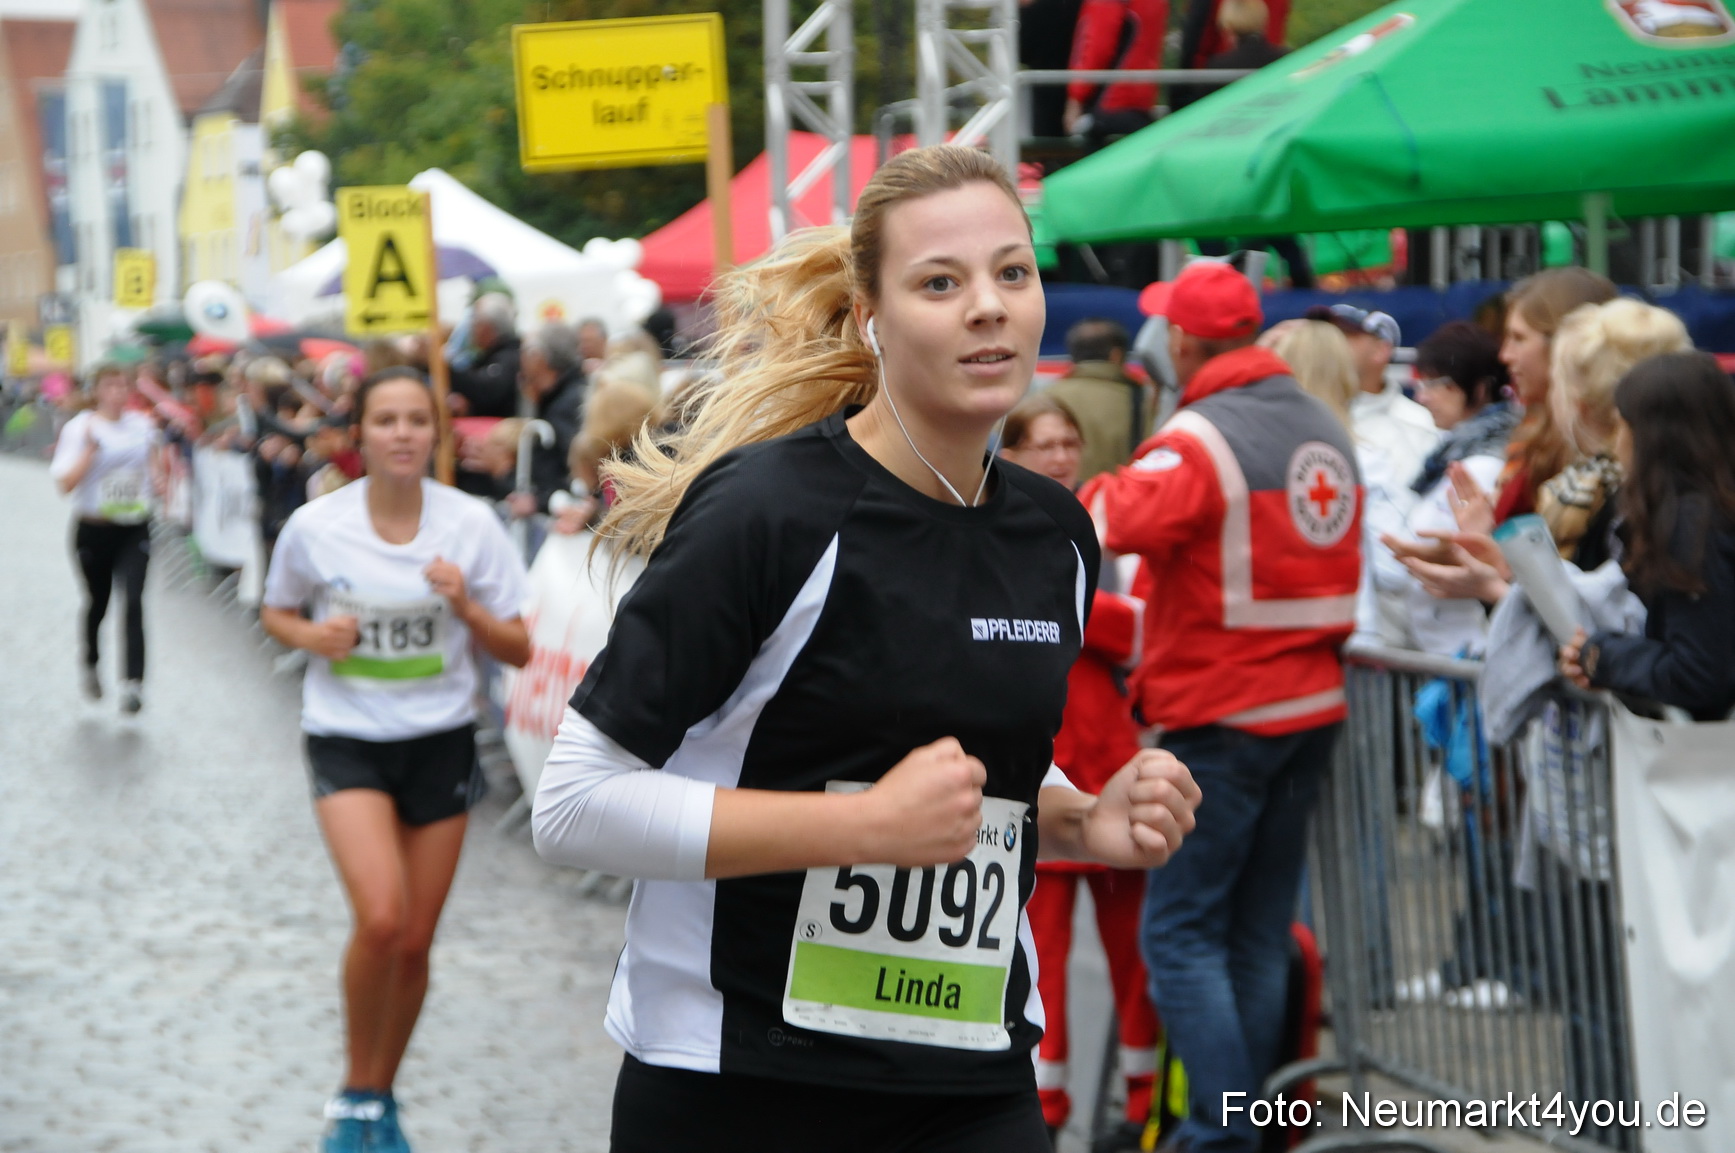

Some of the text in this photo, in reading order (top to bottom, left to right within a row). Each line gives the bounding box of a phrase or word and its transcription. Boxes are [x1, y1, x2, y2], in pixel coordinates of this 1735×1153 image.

[531, 62, 704, 90] Schnupper-
[593, 96, 648, 125] lauf
[349, 192, 424, 218] Block
[366, 232, 417, 299] A
[124, 266, 143, 295] B
[357, 616, 434, 651] 183
[988, 618, 1060, 644] PFLEIDERER
[829, 857, 1005, 950] 5092
[805, 923, 817, 939] S
[875, 966, 961, 1011] Linda
